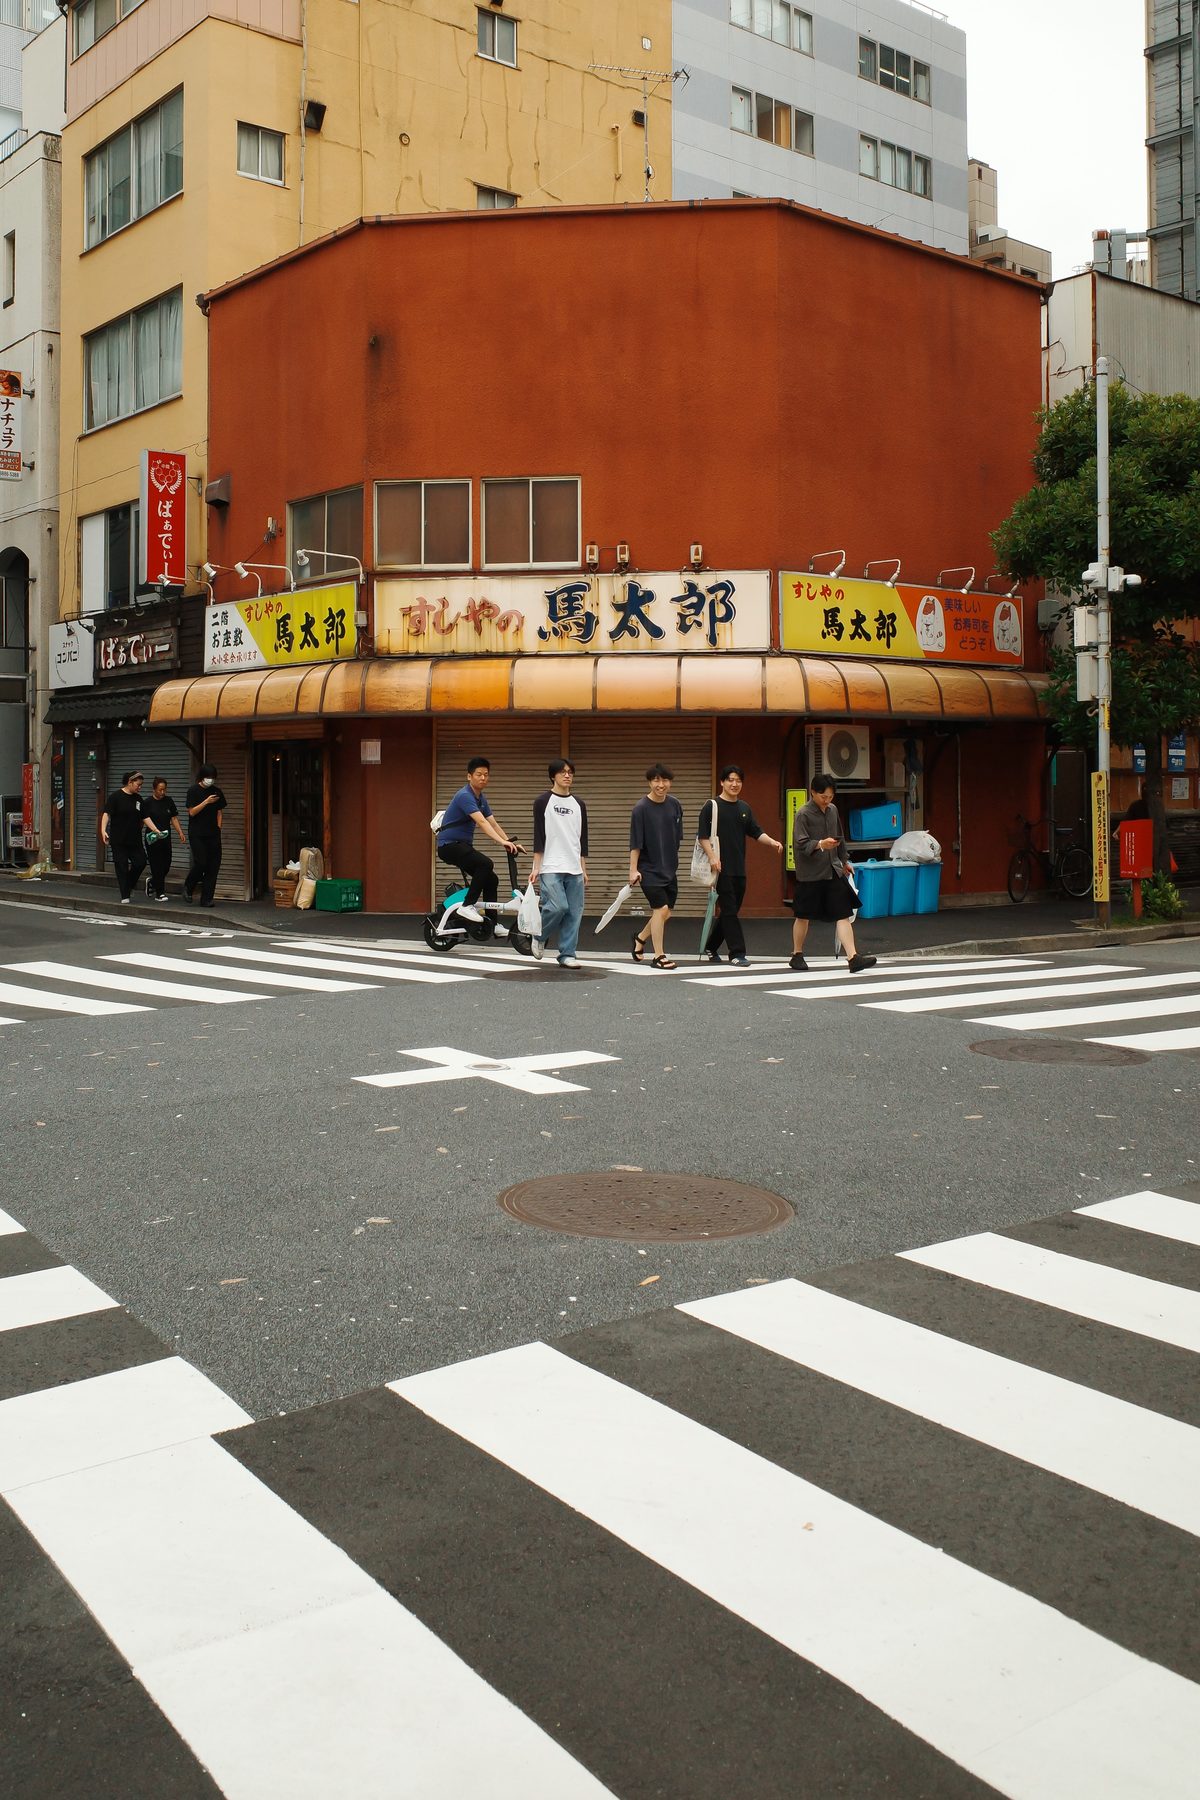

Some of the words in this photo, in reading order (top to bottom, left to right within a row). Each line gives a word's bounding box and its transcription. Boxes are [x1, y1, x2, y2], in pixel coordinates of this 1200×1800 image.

[792, 580, 845, 602] すしやの
[244, 601, 283, 623] すしやの
[399, 596, 525, 636] すしやの
[536, 579, 738, 648] 馬太郎
[944, 598, 982, 614] 美味しい
[211, 610, 229, 627] 二階
[821, 606, 898, 650] 馬太郎
[953, 618, 990, 634] お寿司を
[211, 627, 244, 649] お座敷
[273, 606, 346, 656] 馬太郎
[101, 633, 170, 670] ばぁでぃー
[211, 650, 258, 666] 大小宴会承ります
